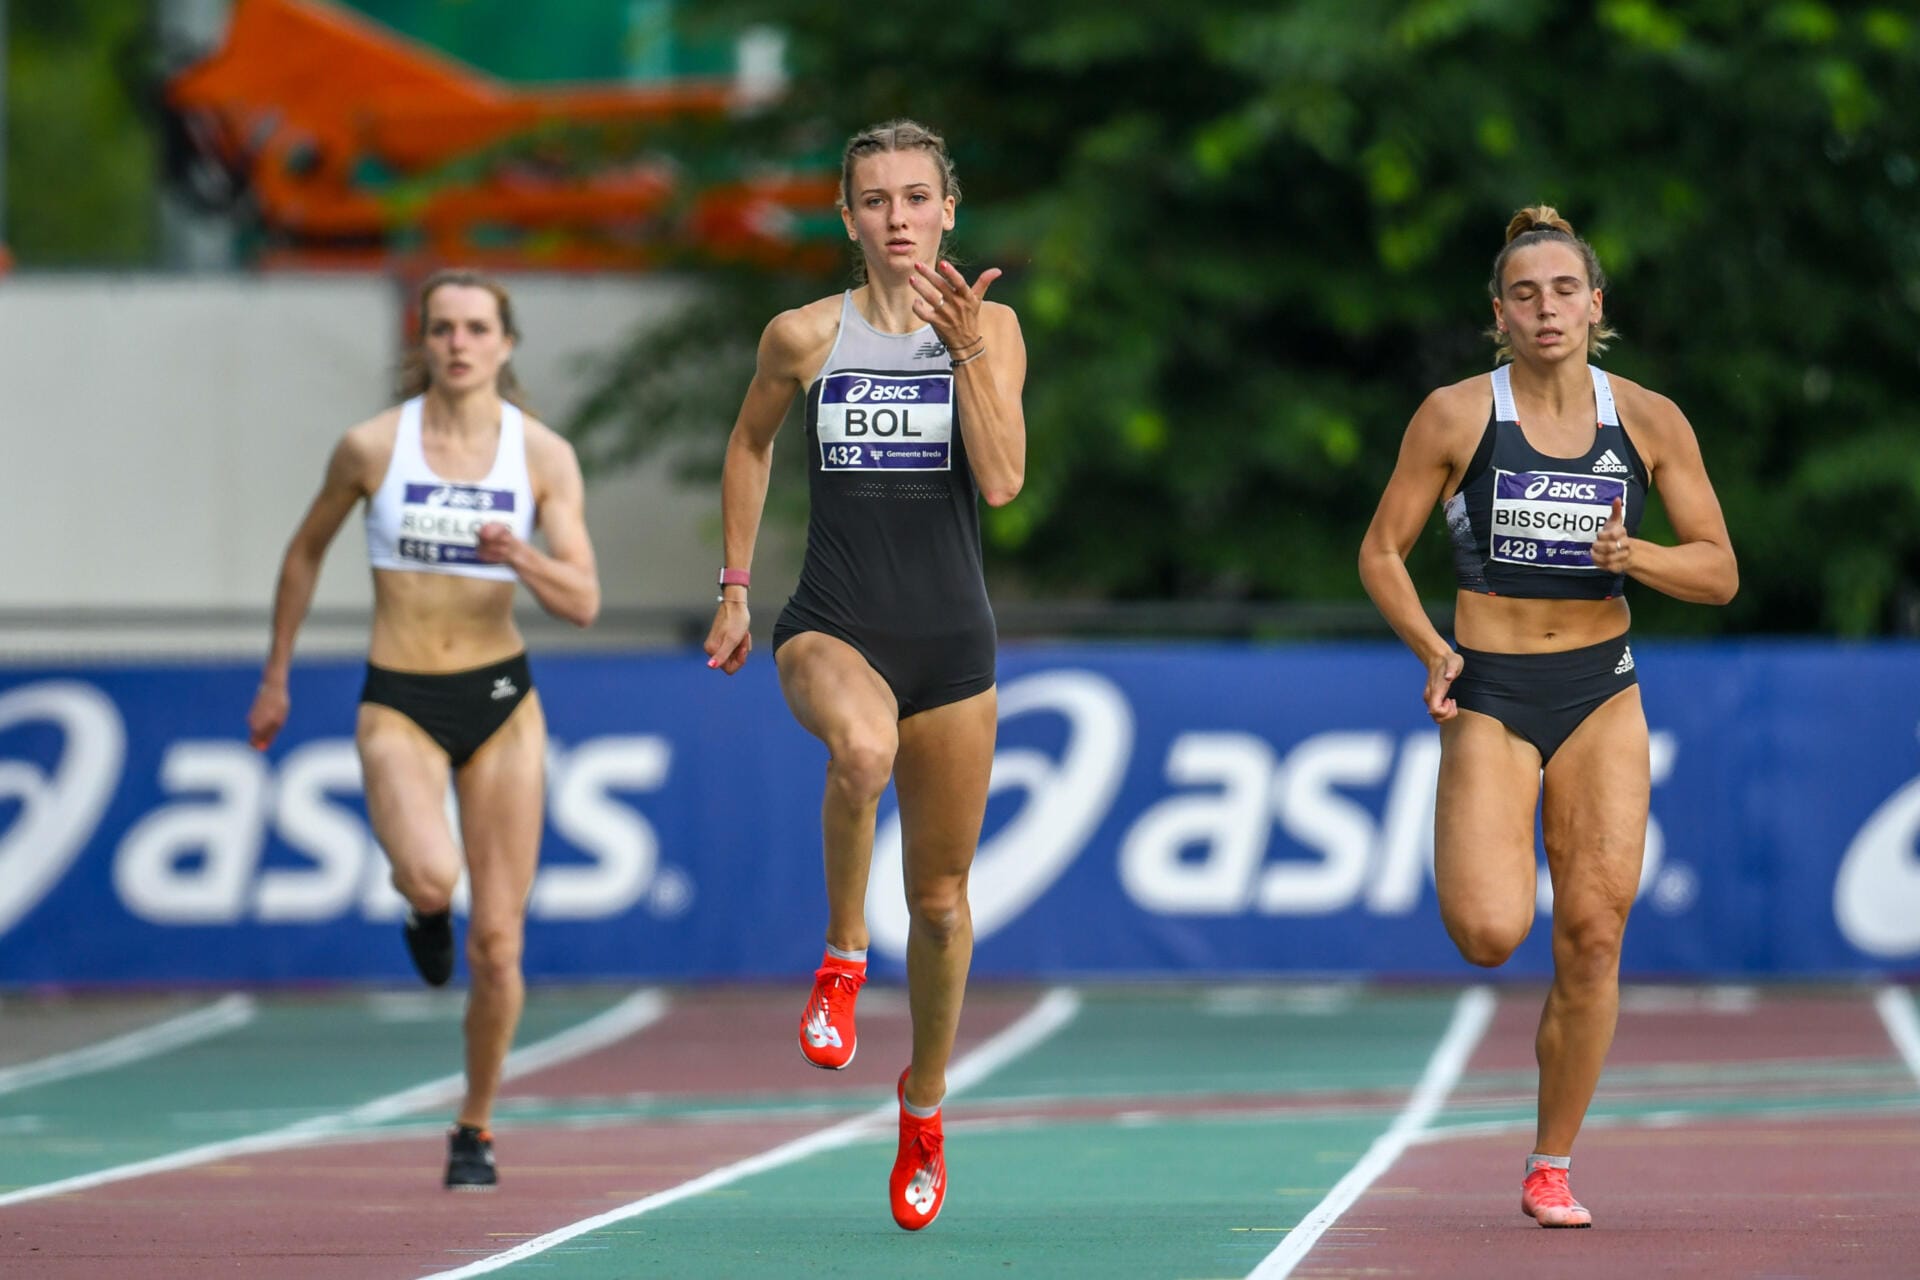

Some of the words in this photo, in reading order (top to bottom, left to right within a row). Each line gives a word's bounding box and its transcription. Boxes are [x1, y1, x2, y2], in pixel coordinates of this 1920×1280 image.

[845, 409, 922, 437] BOL
[828, 446, 862, 465] 432
[886, 450, 921, 458] Gemeente
[922, 450, 942, 458] Breda
[1592, 463, 1628, 473] adidas
[1495, 509, 1609, 533] BISSCHOP
[1498, 540, 1537, 560] 428
